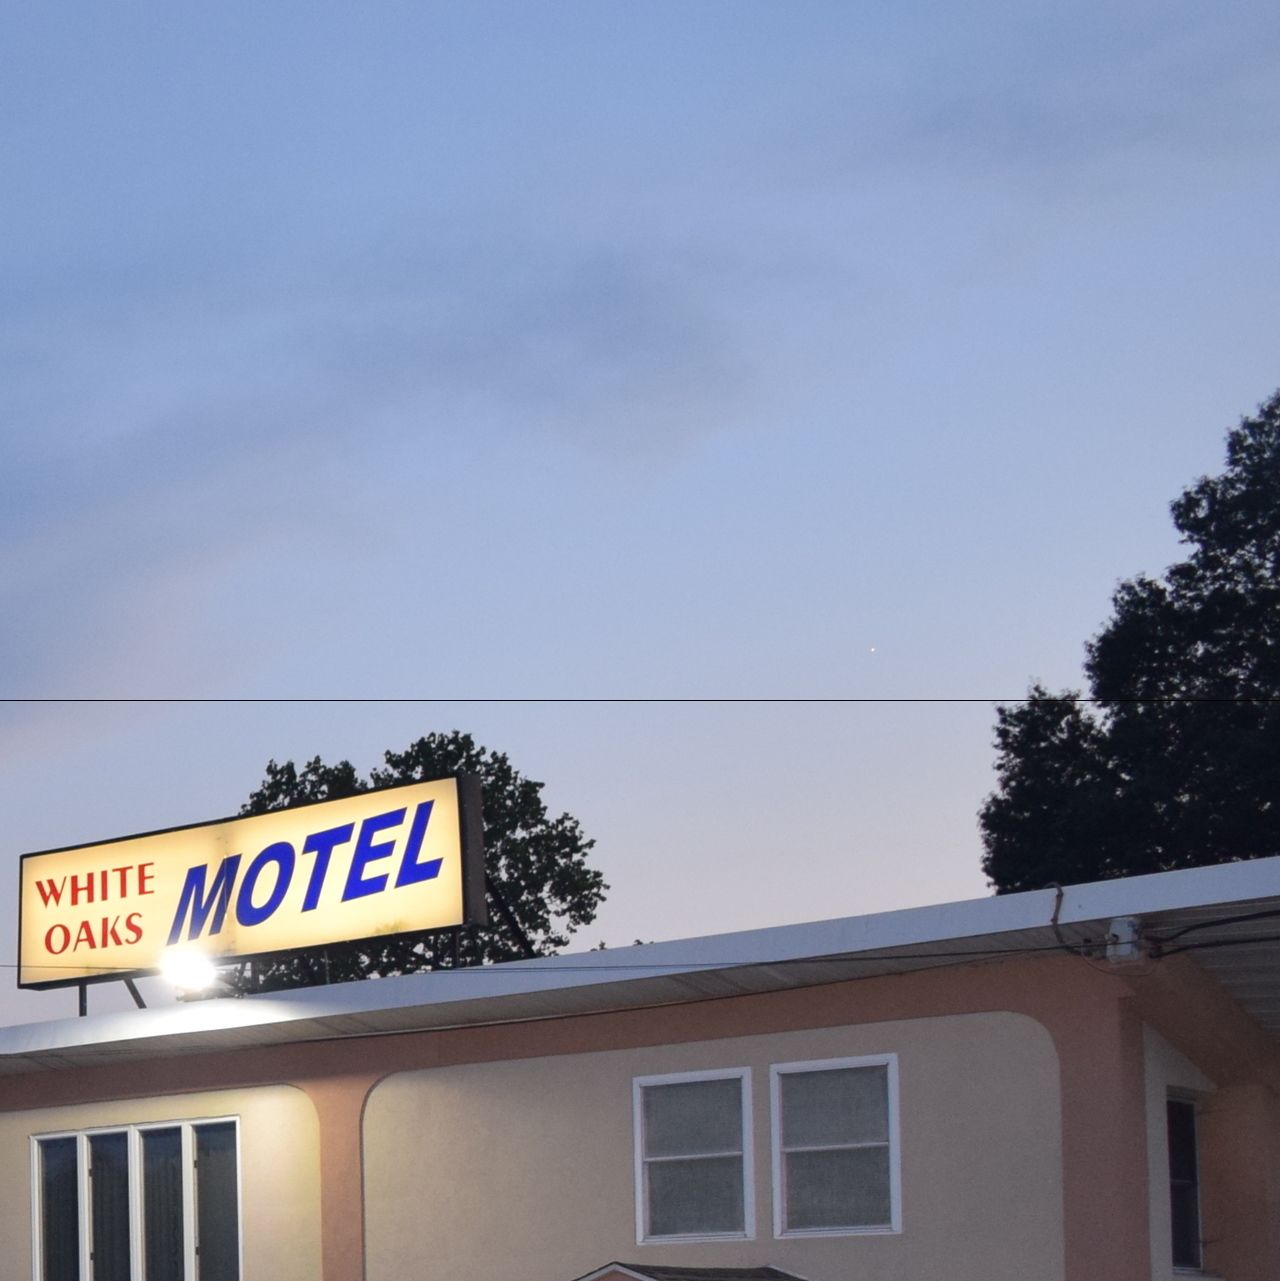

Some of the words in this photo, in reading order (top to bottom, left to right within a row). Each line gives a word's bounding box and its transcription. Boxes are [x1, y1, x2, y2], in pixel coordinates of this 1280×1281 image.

[35, 862, 155, 909] WHITE
[166, 799, 444, 946] MOTEL
[44, 912, 144, 956] OAKS
